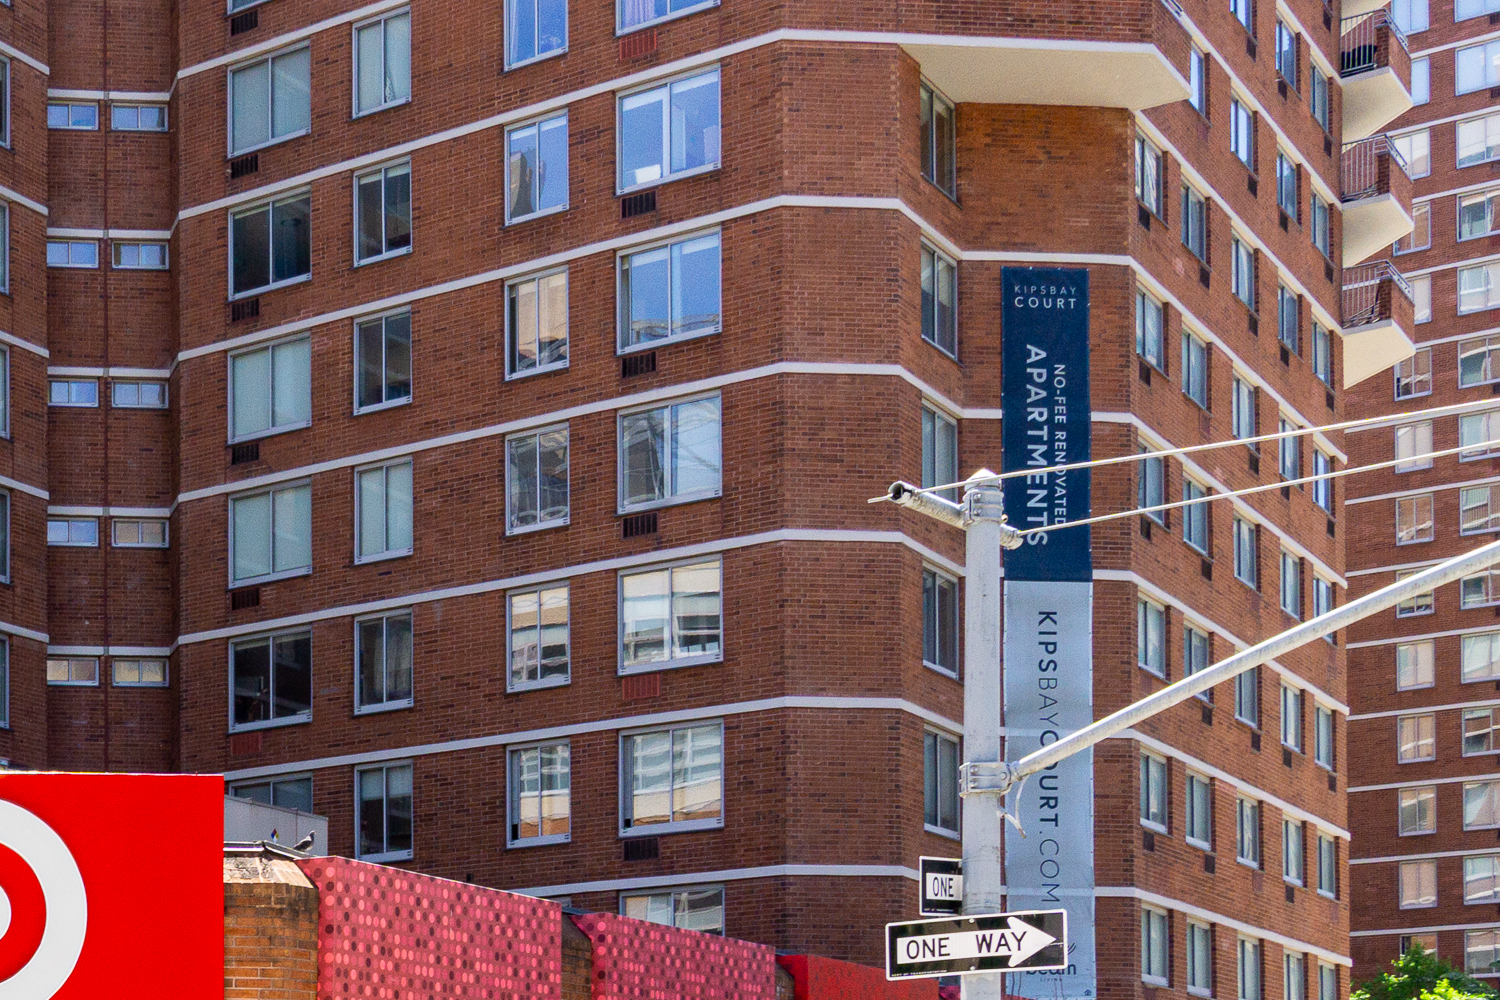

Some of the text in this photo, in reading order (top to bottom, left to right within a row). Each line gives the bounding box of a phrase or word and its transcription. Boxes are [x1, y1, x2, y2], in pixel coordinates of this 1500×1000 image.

[1014, 285, 1077, 295] KIPSBAY
[1014, 297, 1077, 309] COURT
[1026, 343, 1048, 546] APARTMENTS
[1053, 364, 1067, 525] NO-FEE RENOVATED
[932, 876, 954, 898] ONE
[906, 930, 1027, 959] ONE WAY
